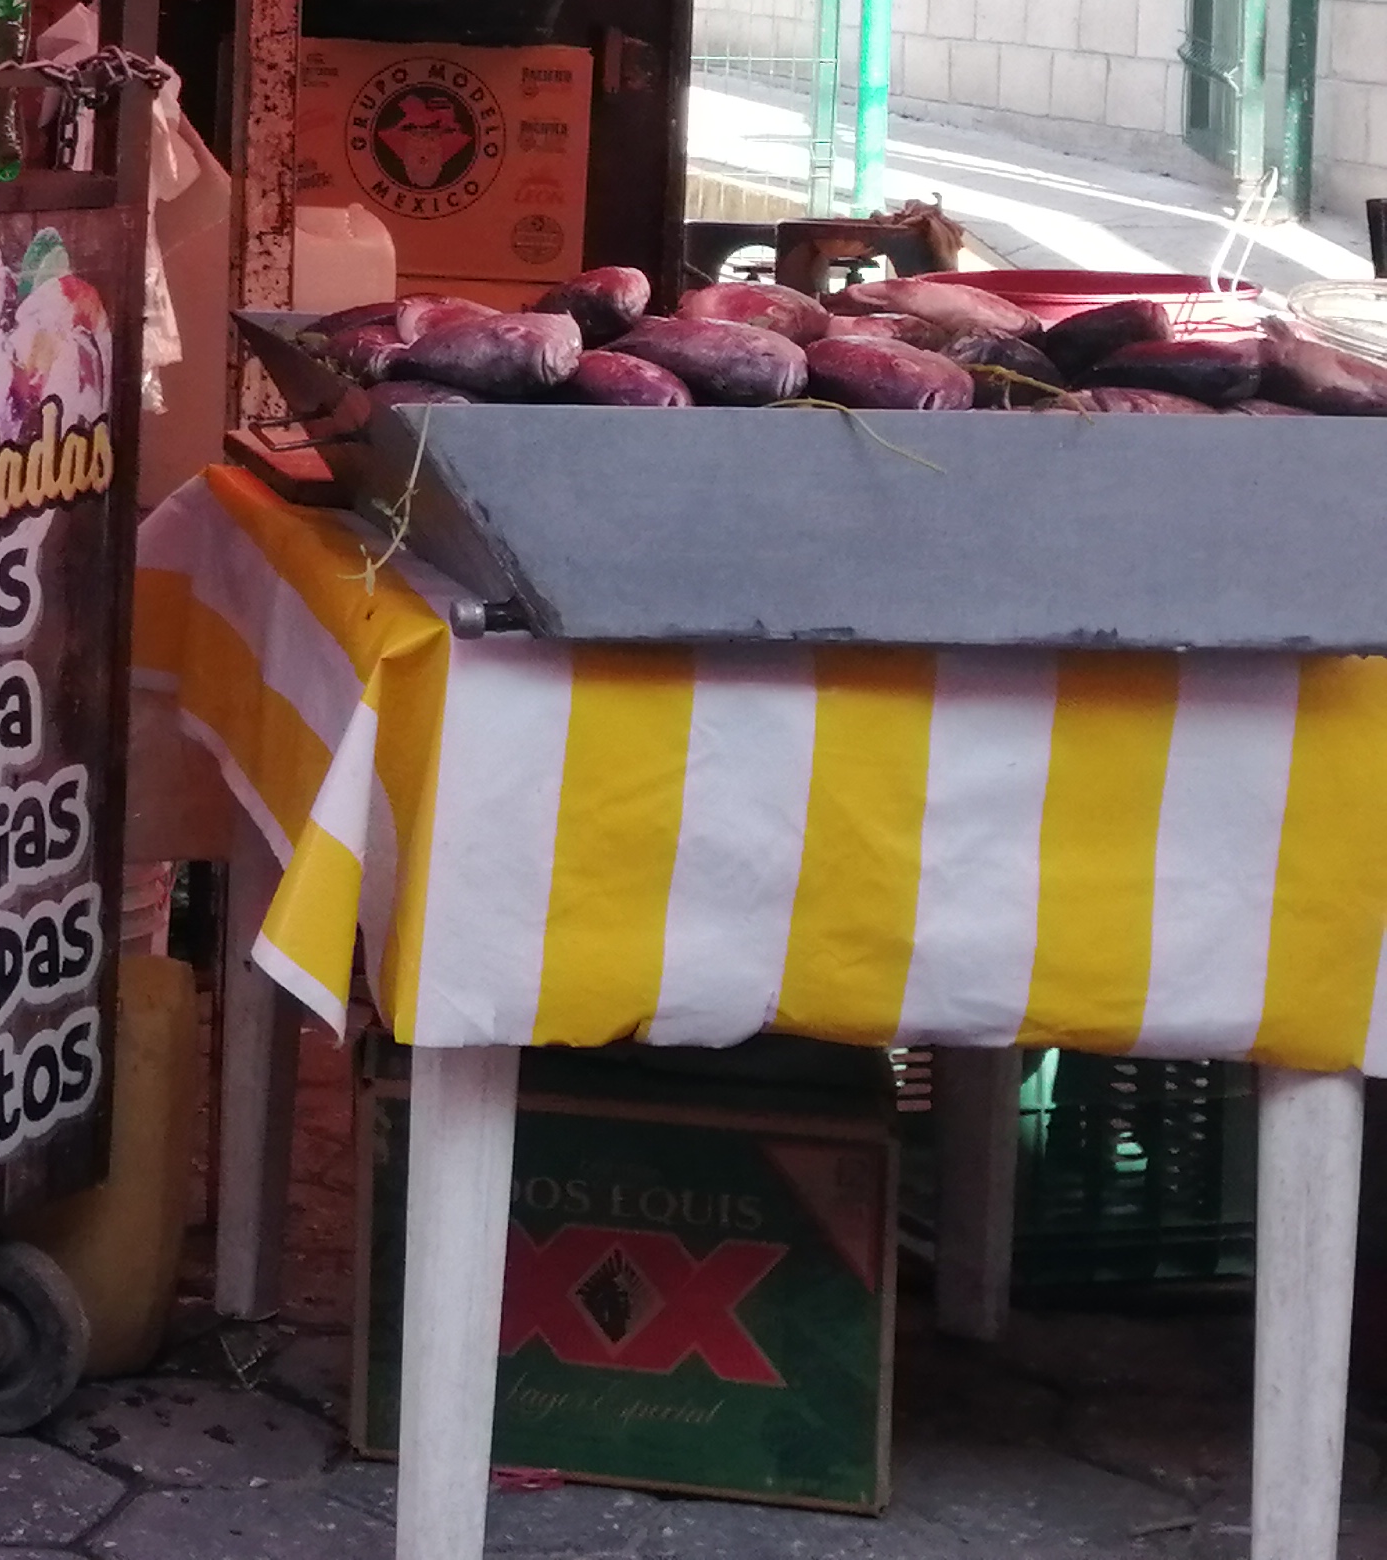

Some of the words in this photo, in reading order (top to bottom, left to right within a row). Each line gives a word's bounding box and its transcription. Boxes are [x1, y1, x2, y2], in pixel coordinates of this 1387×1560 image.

[351, 67, 409, 152] GRUPO
[428, 64, 499, 160] MODELO
[371, 179, 480, 214] MEXICO
[610, 1183, 764, 1232] EQUIS
